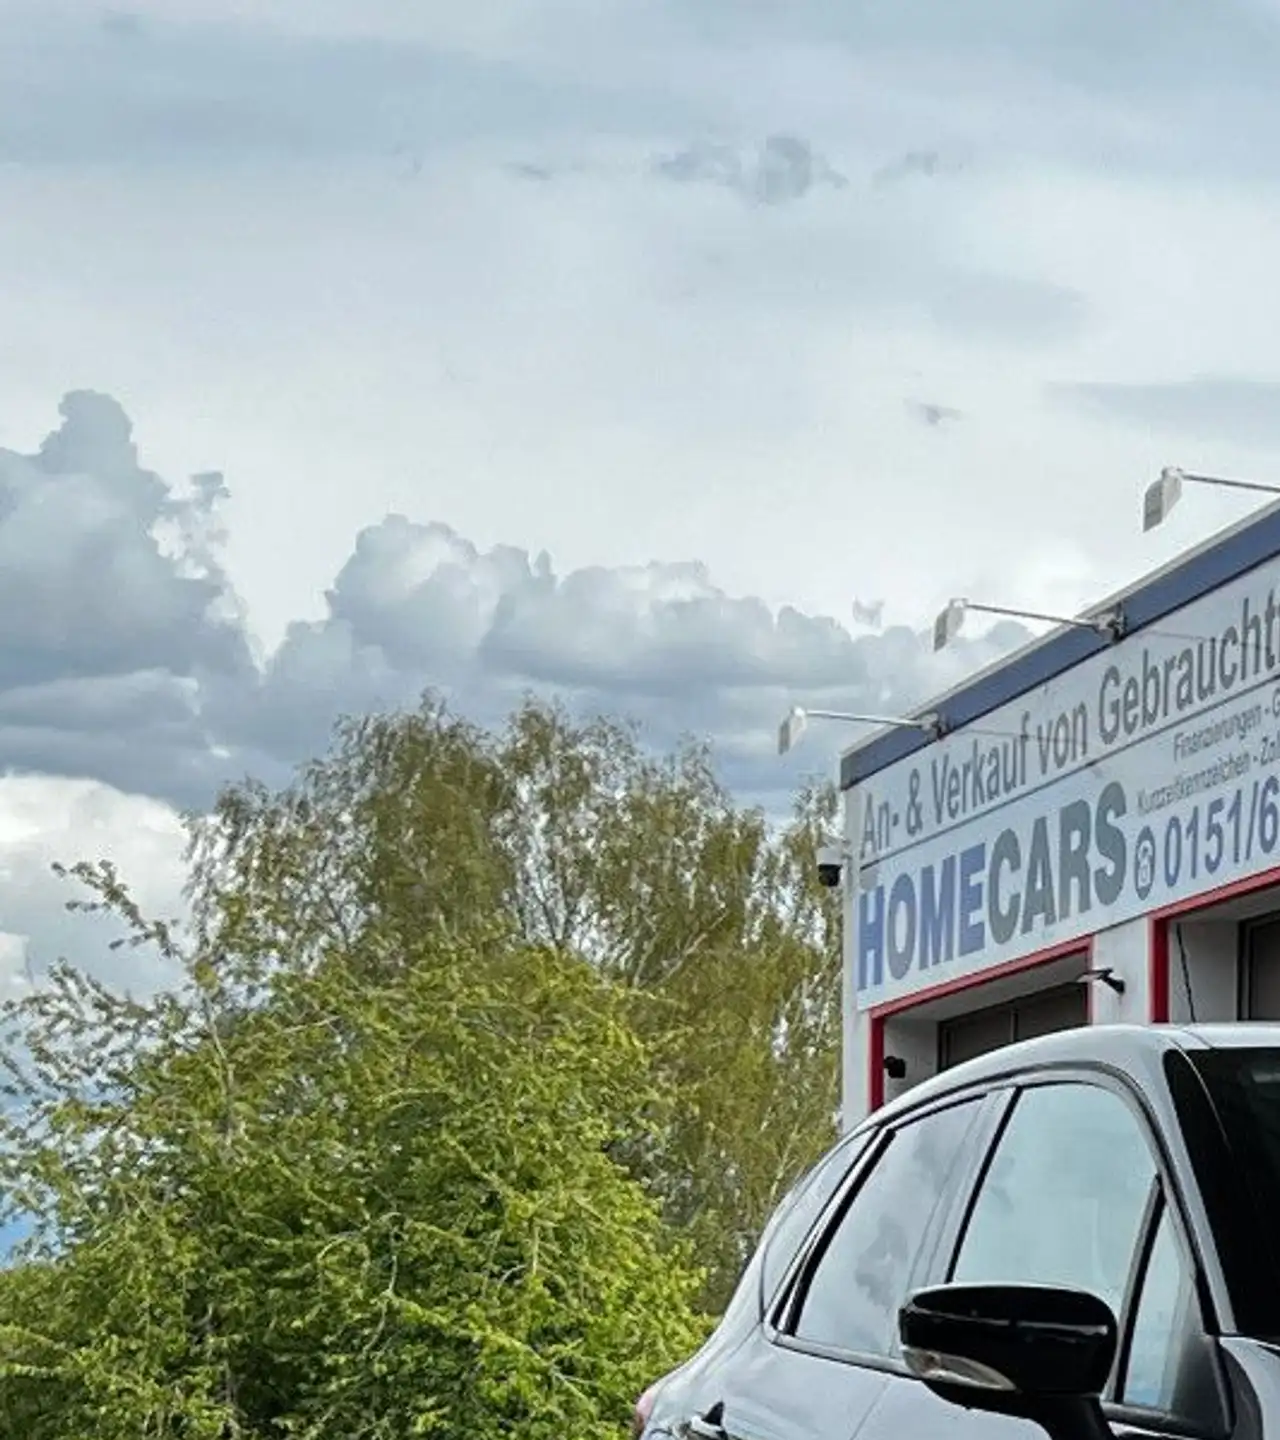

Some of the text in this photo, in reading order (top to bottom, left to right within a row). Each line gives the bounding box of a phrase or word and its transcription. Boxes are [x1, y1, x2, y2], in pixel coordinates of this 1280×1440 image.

[859, 793, 899, 860] An-
[906, 768, 924, 837] &
[931, 709, 1031, 825] Verkauf
[1037, 700, 1089, 776] von
[856, 781, 1127, 991] HOMECARS
